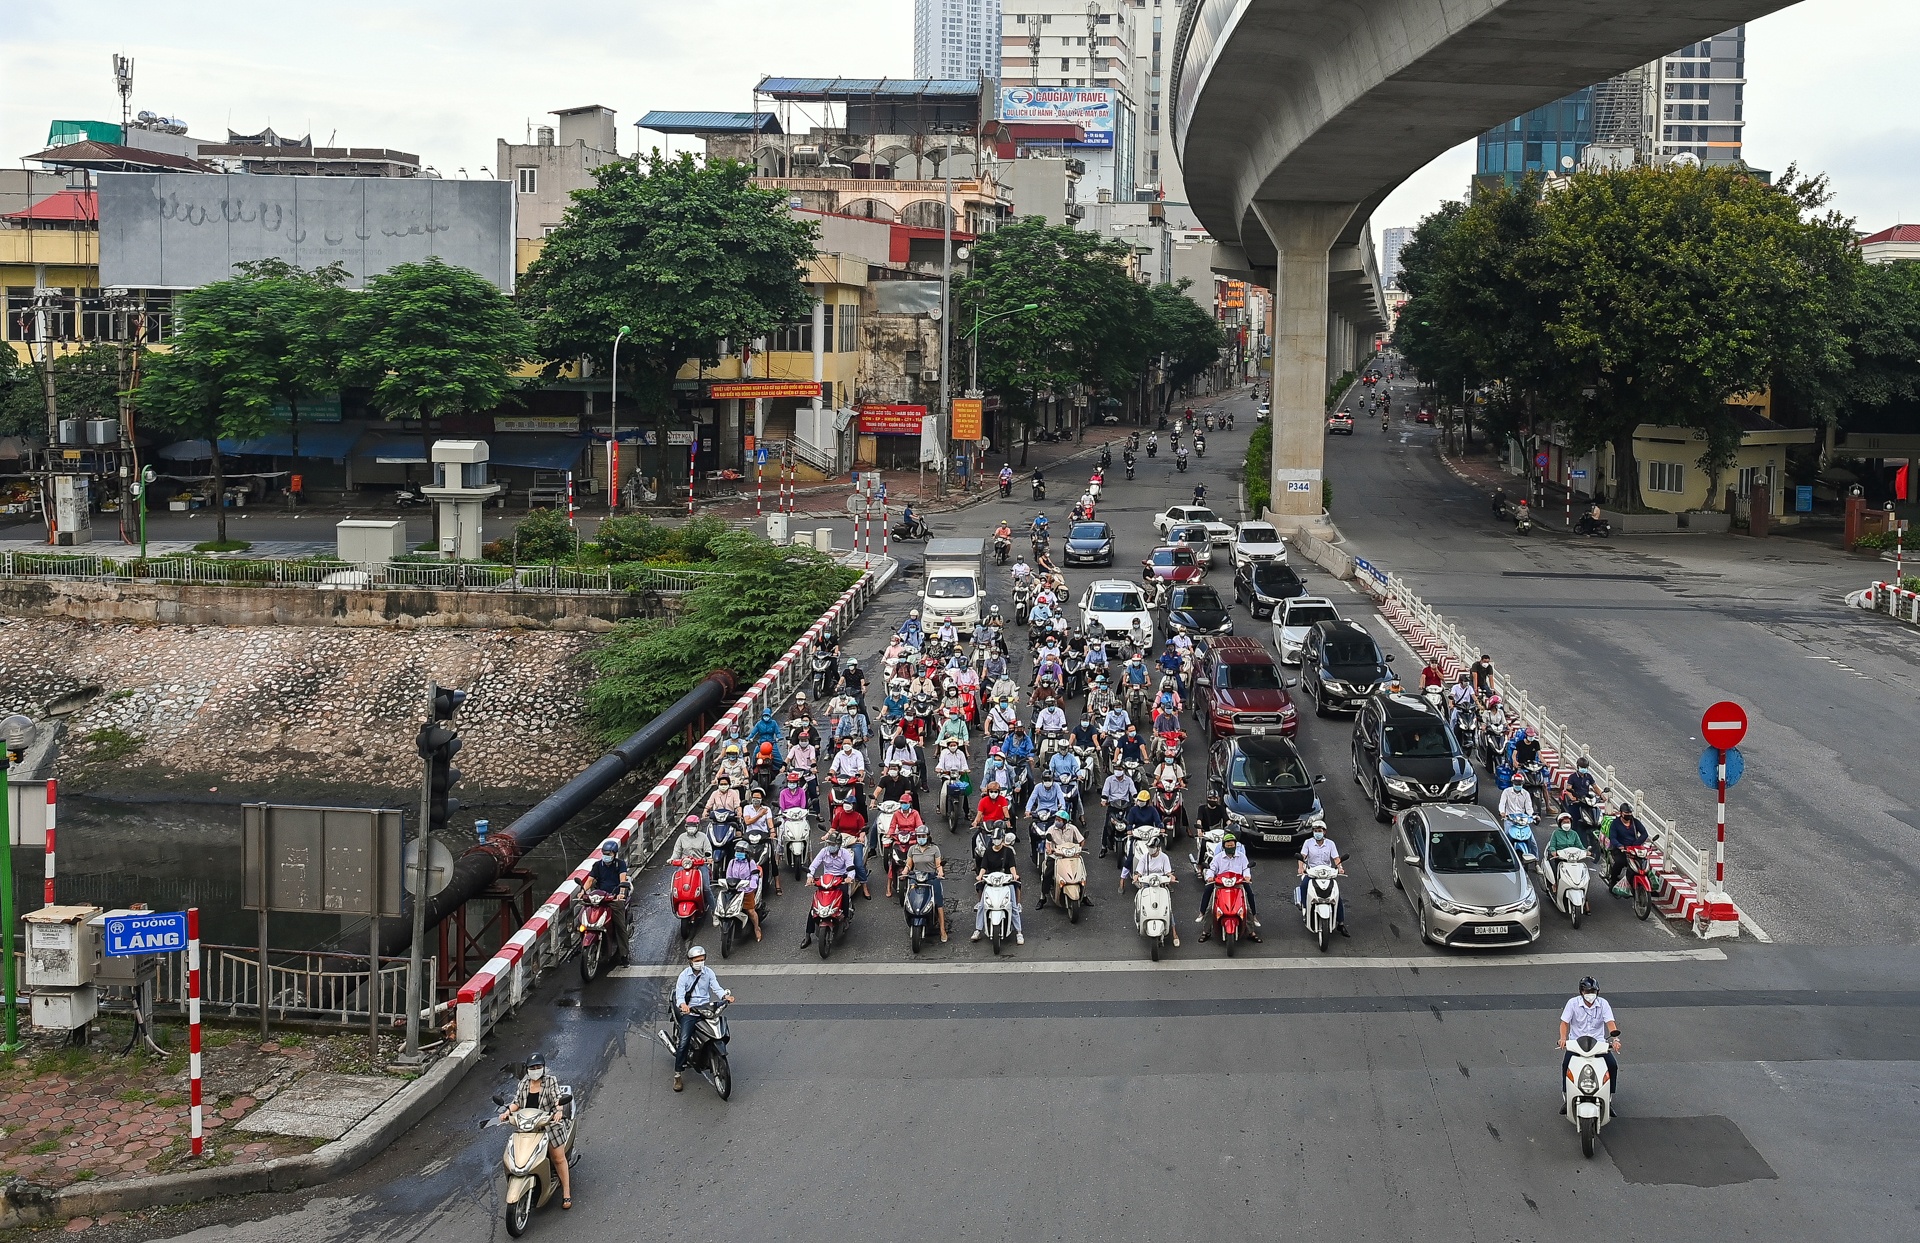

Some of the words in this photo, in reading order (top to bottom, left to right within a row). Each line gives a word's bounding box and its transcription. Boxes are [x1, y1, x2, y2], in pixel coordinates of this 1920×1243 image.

[1035, 92, 1073, 102] CAUGIAY
[1076, 92, 1108, 103] TRAVEL
[114, 932, 179, 950] LÁNG
